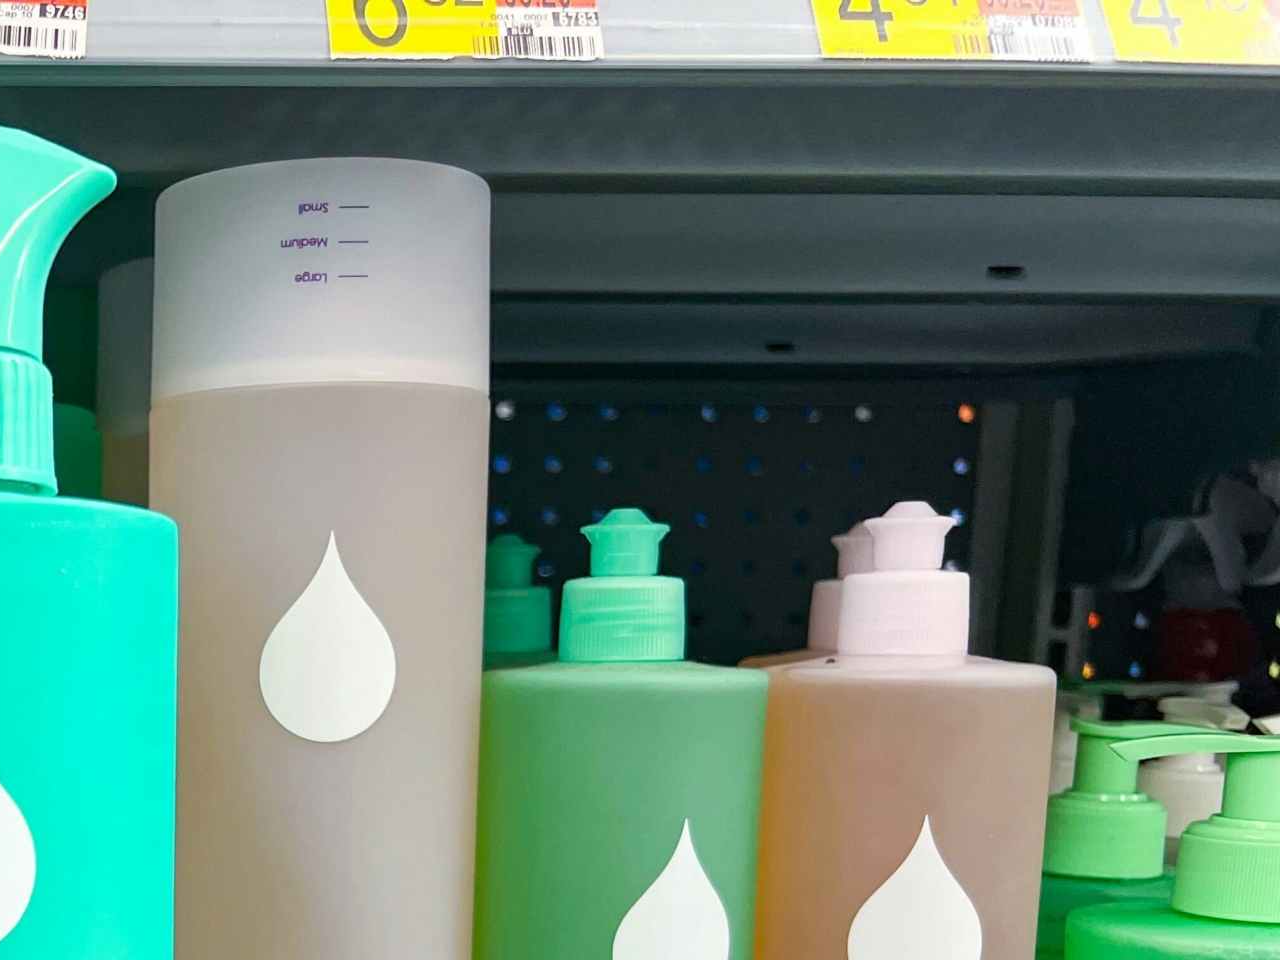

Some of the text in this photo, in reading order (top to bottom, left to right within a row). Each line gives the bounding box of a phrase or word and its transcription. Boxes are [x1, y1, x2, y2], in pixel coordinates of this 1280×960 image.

[46, 5, 84, 20] 9746
[559, 12, 597, 26] 6783
[299, 202, 328, 215] Small
[280, 237, 328, 249] Medium
[294, 272, 328, 283] Large
